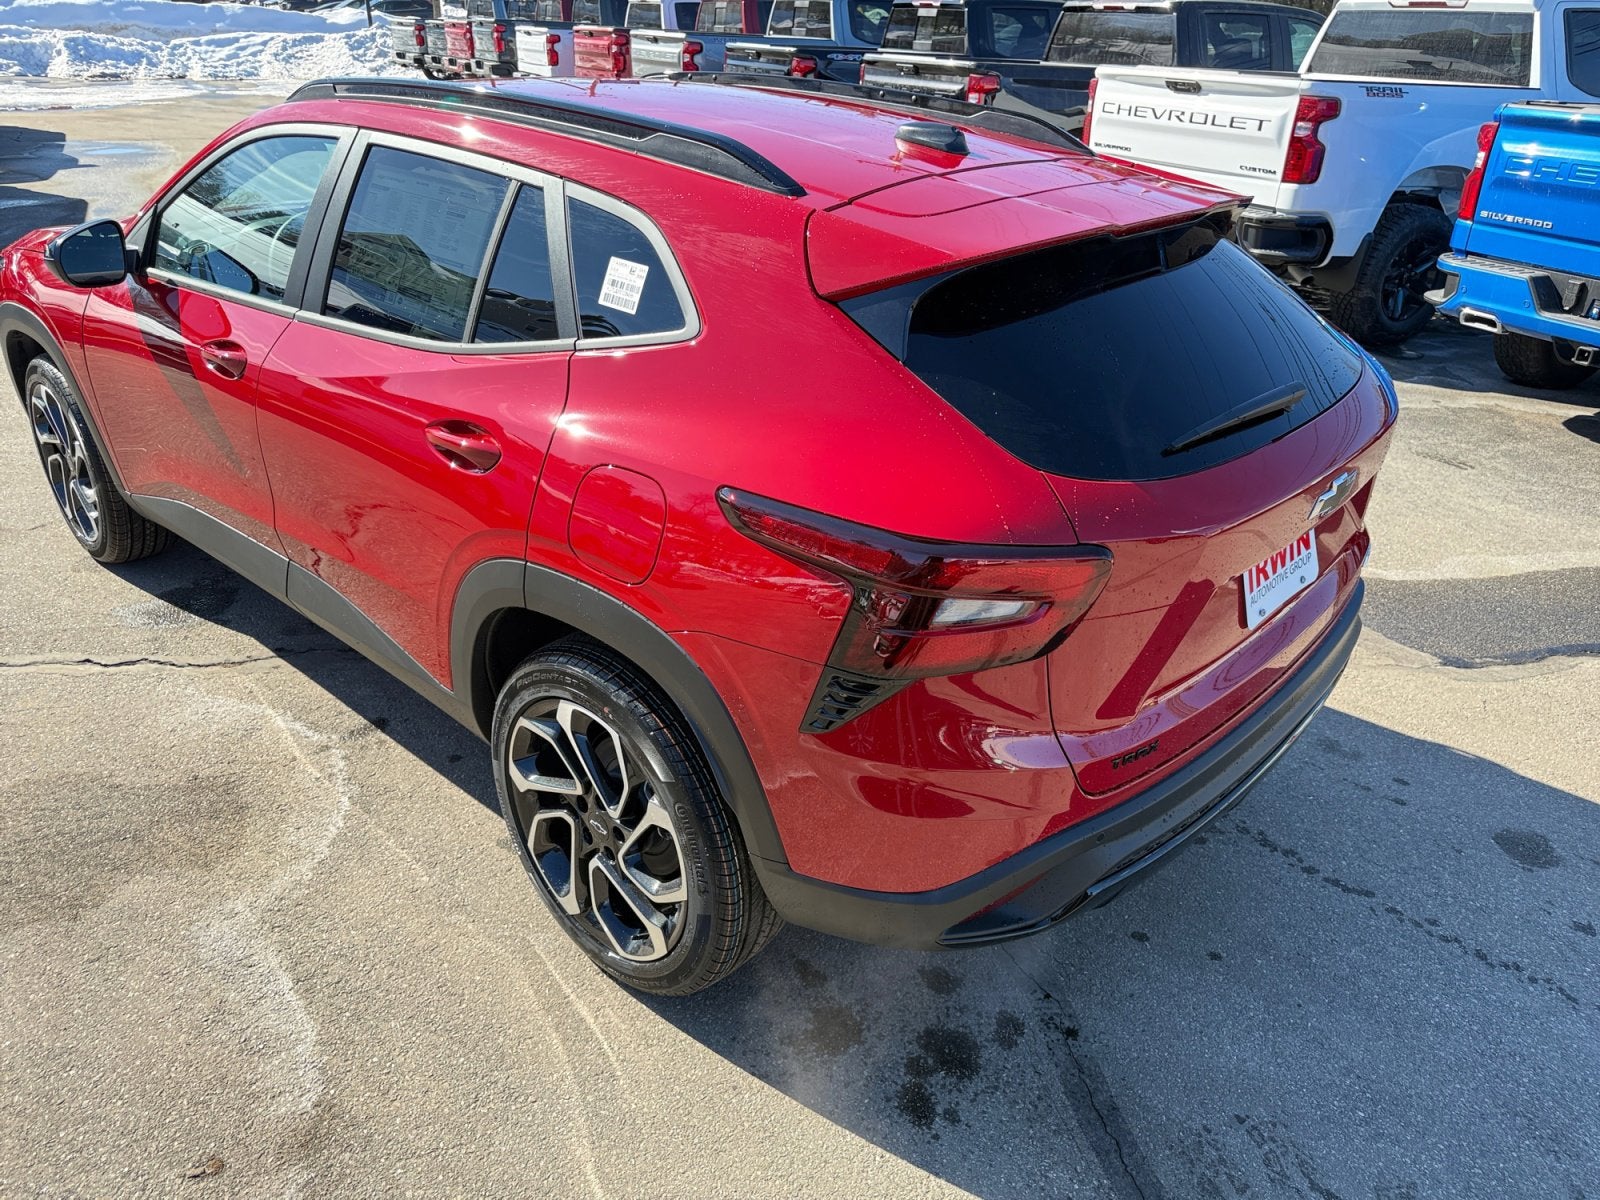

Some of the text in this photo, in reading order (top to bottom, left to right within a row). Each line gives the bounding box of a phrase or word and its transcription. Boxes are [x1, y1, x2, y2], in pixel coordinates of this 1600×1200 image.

[1101, 101, 1273, 132] CHEVROLET
[1094, 142, 1131, 151] SILVERADO
[1239, 165, 1277, 175] CUSTOM
[1480, 210, 1553, 229] SILVERADO
[1250, 552, 1312, 607] AUTOMOTIVE GROUP
[1111, 740, 1160, 769] TRAX
